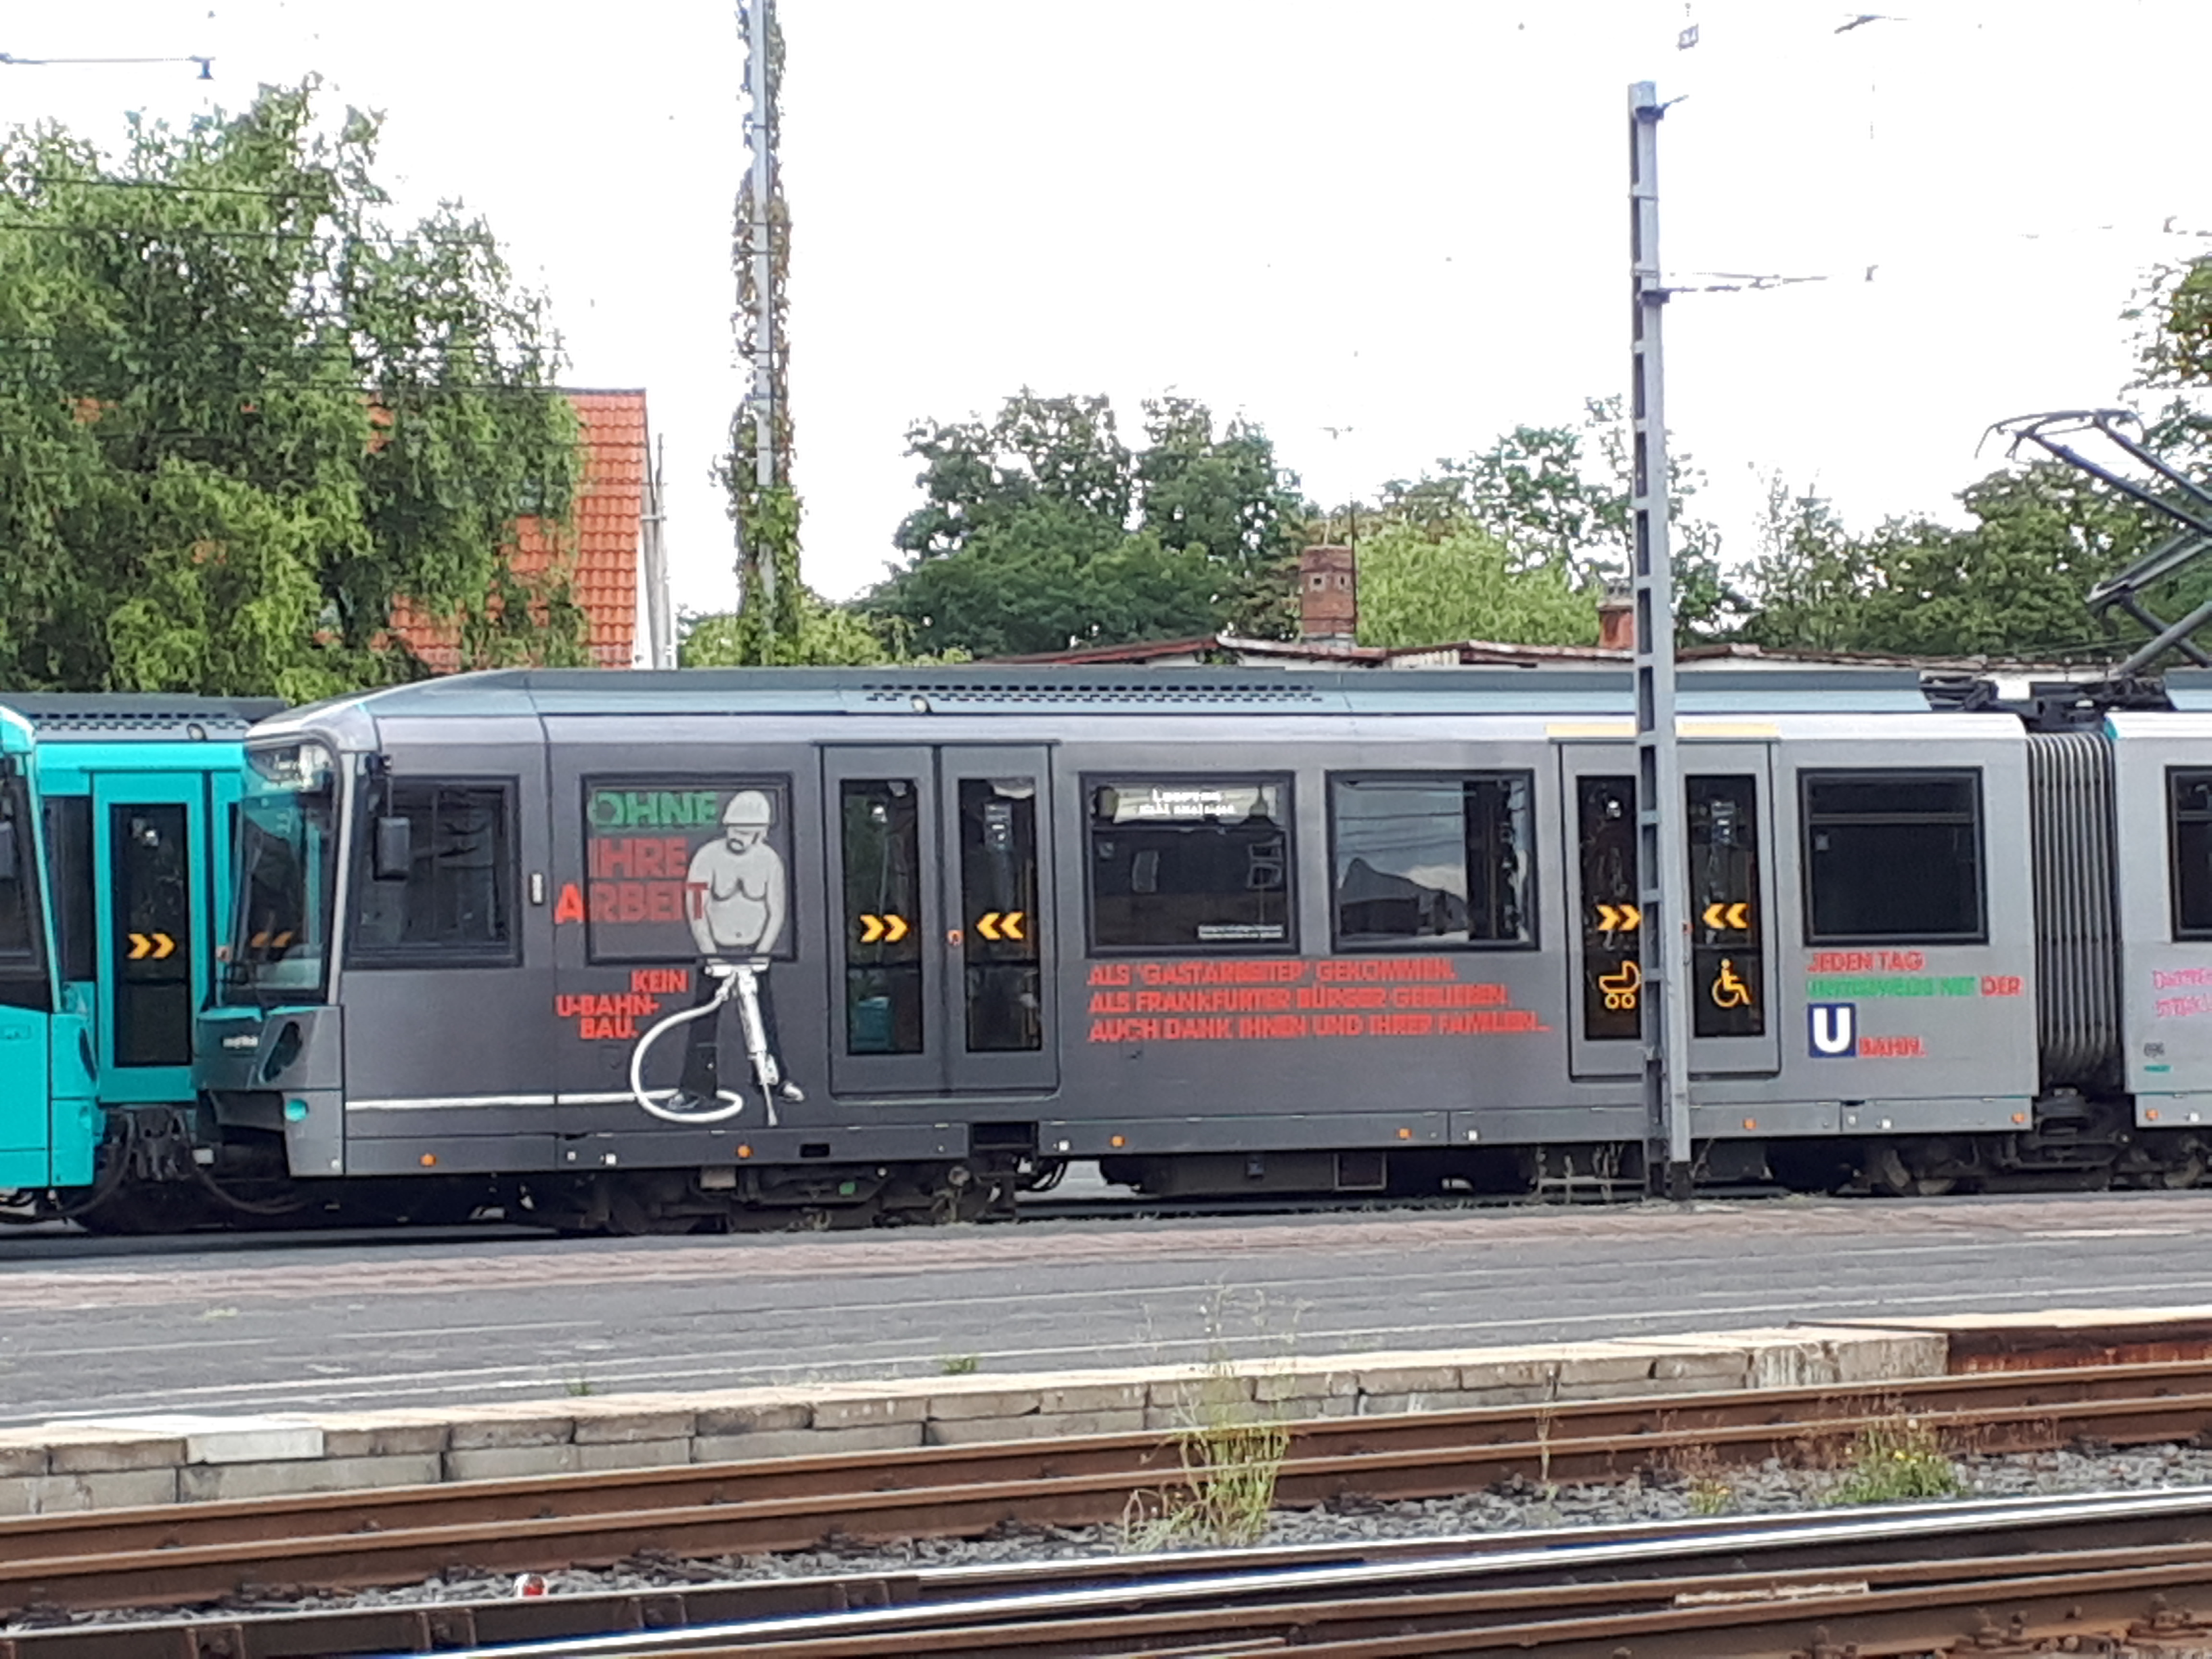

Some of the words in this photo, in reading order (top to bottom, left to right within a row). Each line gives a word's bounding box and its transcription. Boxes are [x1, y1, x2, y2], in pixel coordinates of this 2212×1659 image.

[588, 791, 718, 827] OHNE
[589, 837, 688, 878] IHRE
[554, 881, 709, 924] ARBEIT
[1087, 963, 1130, 986] ALS
[1807, 951, 1874, 973] JEDEN
[1877, 950, 1925, 972] TAG
[631, 969, 688, 993] KEIN
[1981, 975, 2024, 997] DER
[1088, 990, 1130, 1013] ALS
[1087, 1017, 1160, 1042] AUCH
[1165, 1016, 1233, 1041] DANK
[1311, 1014, 1364, 1037] UND
[1813, 1007, 1851, 1053] U
